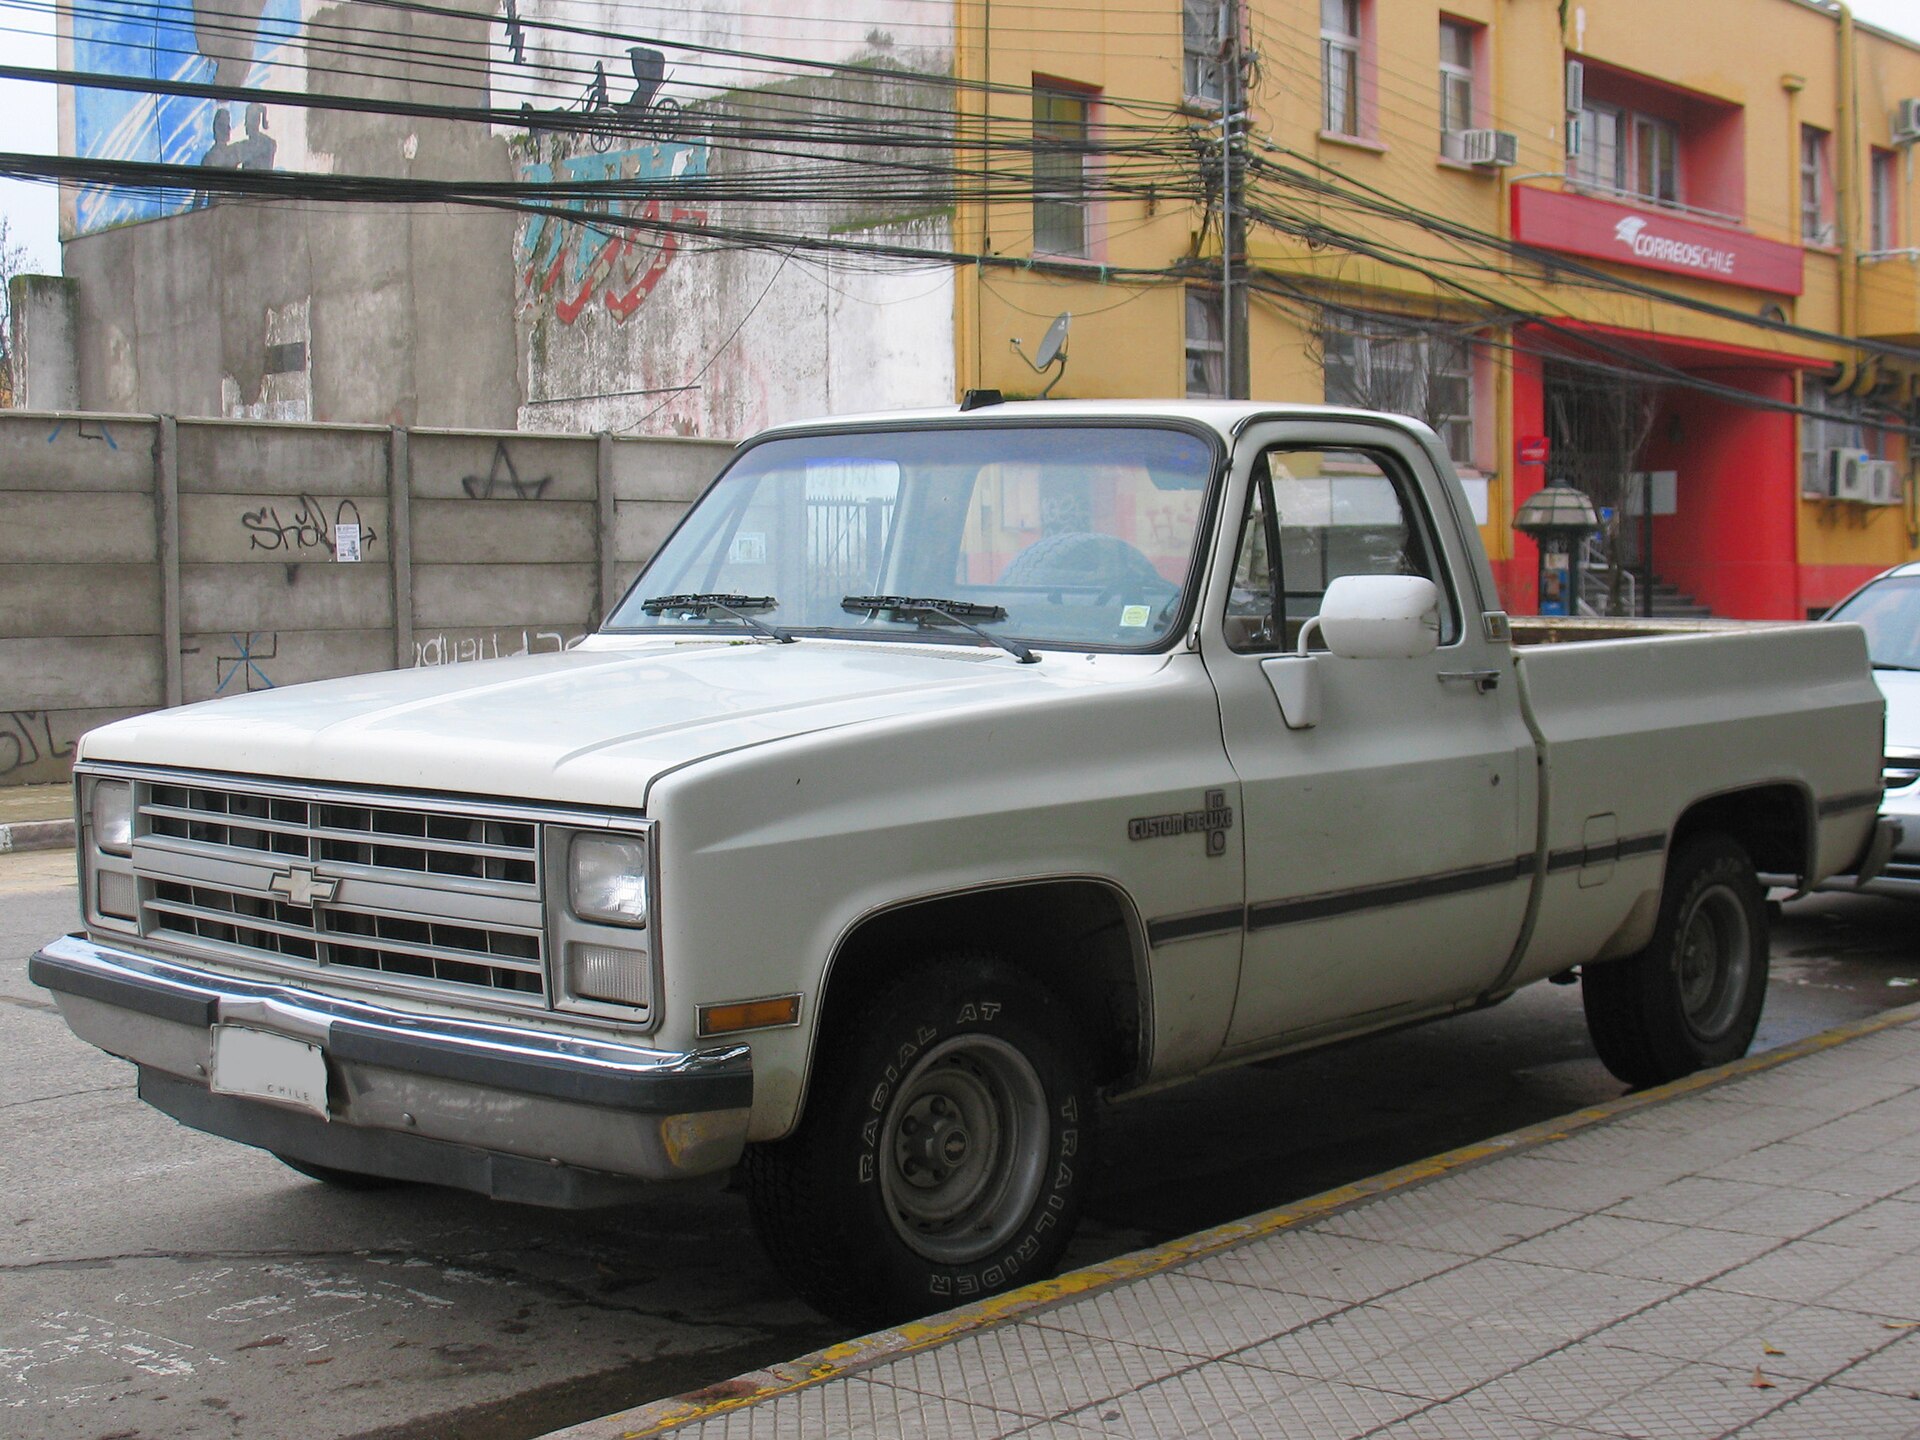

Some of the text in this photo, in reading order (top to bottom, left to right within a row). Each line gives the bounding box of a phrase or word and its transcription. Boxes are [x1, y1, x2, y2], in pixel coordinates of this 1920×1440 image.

[1129, 808, 1232, 839] CUSTOM DELUXE
[267, 1083, 310, 1101] CHILE
[859, 1002, 1001, 1183] RADIAL AT
